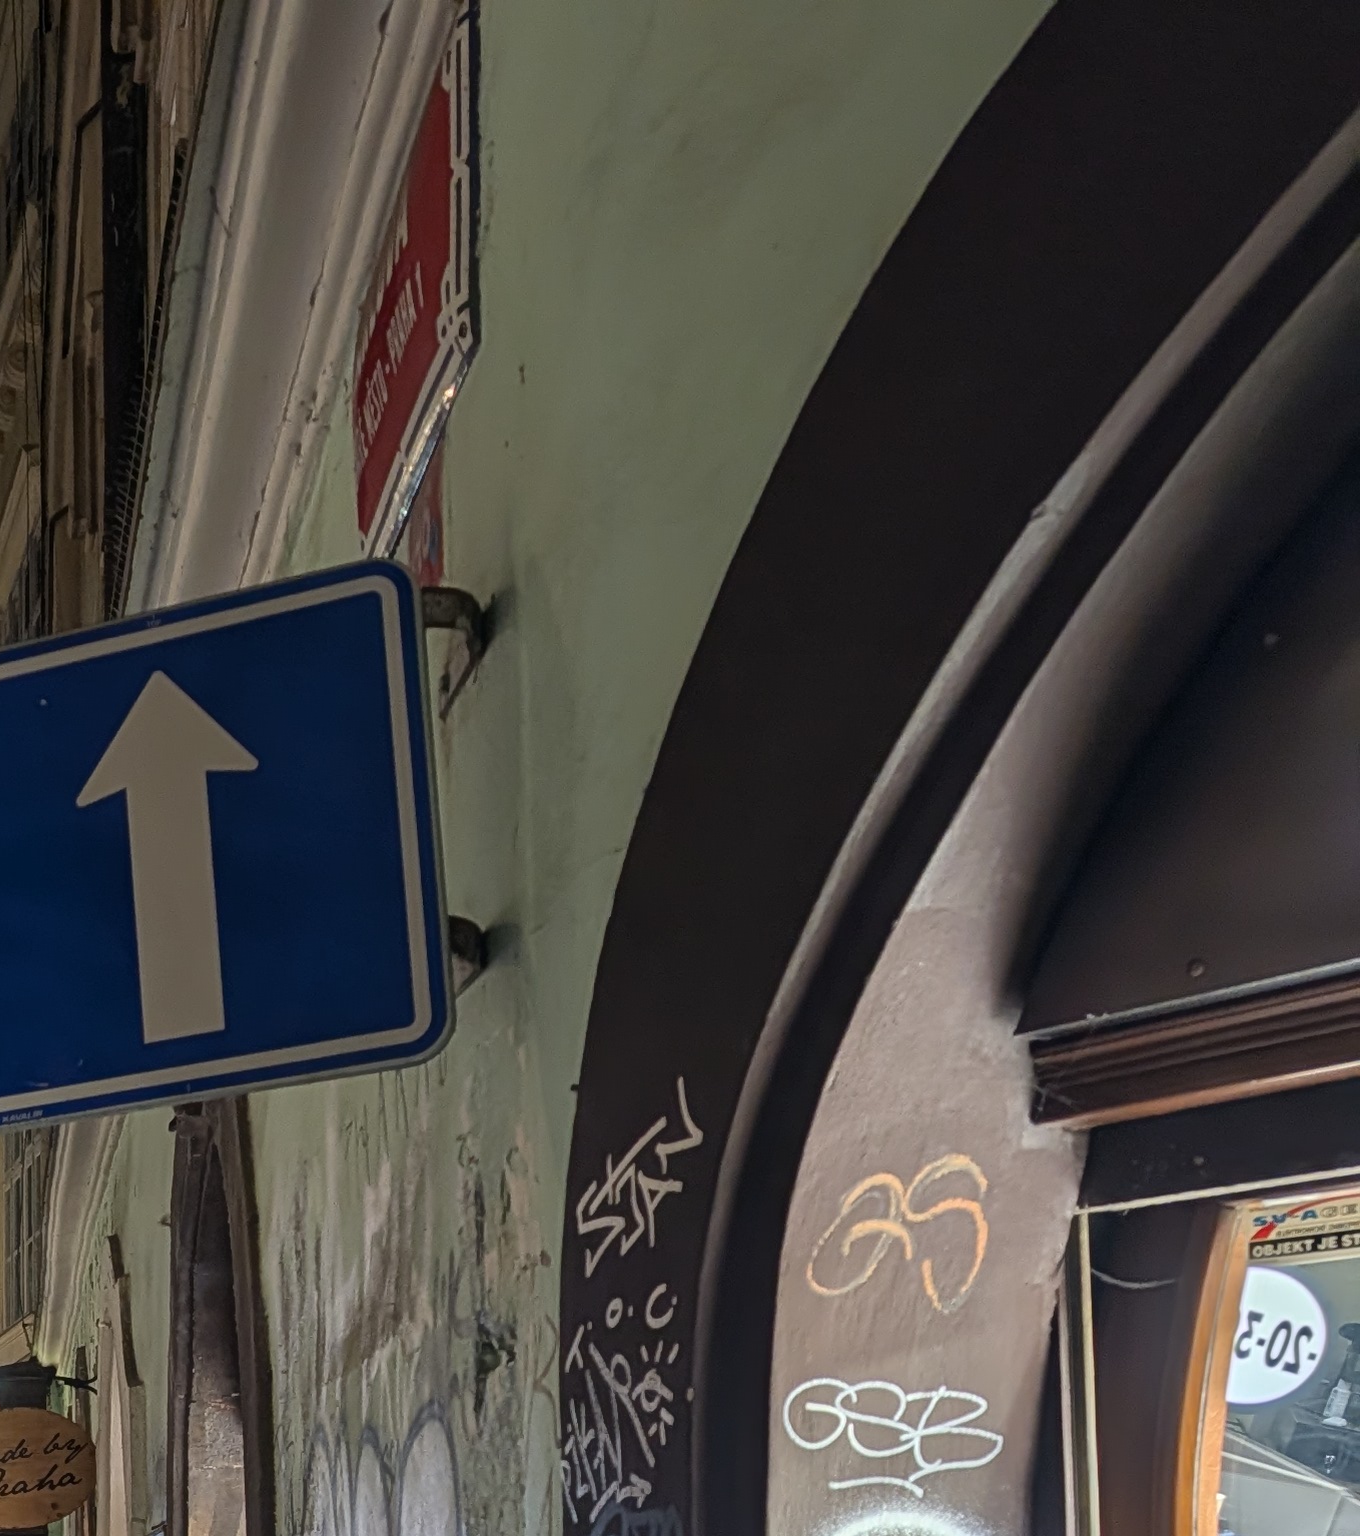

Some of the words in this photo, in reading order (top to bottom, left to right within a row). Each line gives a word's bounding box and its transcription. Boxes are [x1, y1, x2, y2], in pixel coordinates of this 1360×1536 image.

[1252, 1239, 1315, 1258] OBJEKT
[1317, 1236, 1339, 1250] JE
[43, 1432, 89, 1465] by
